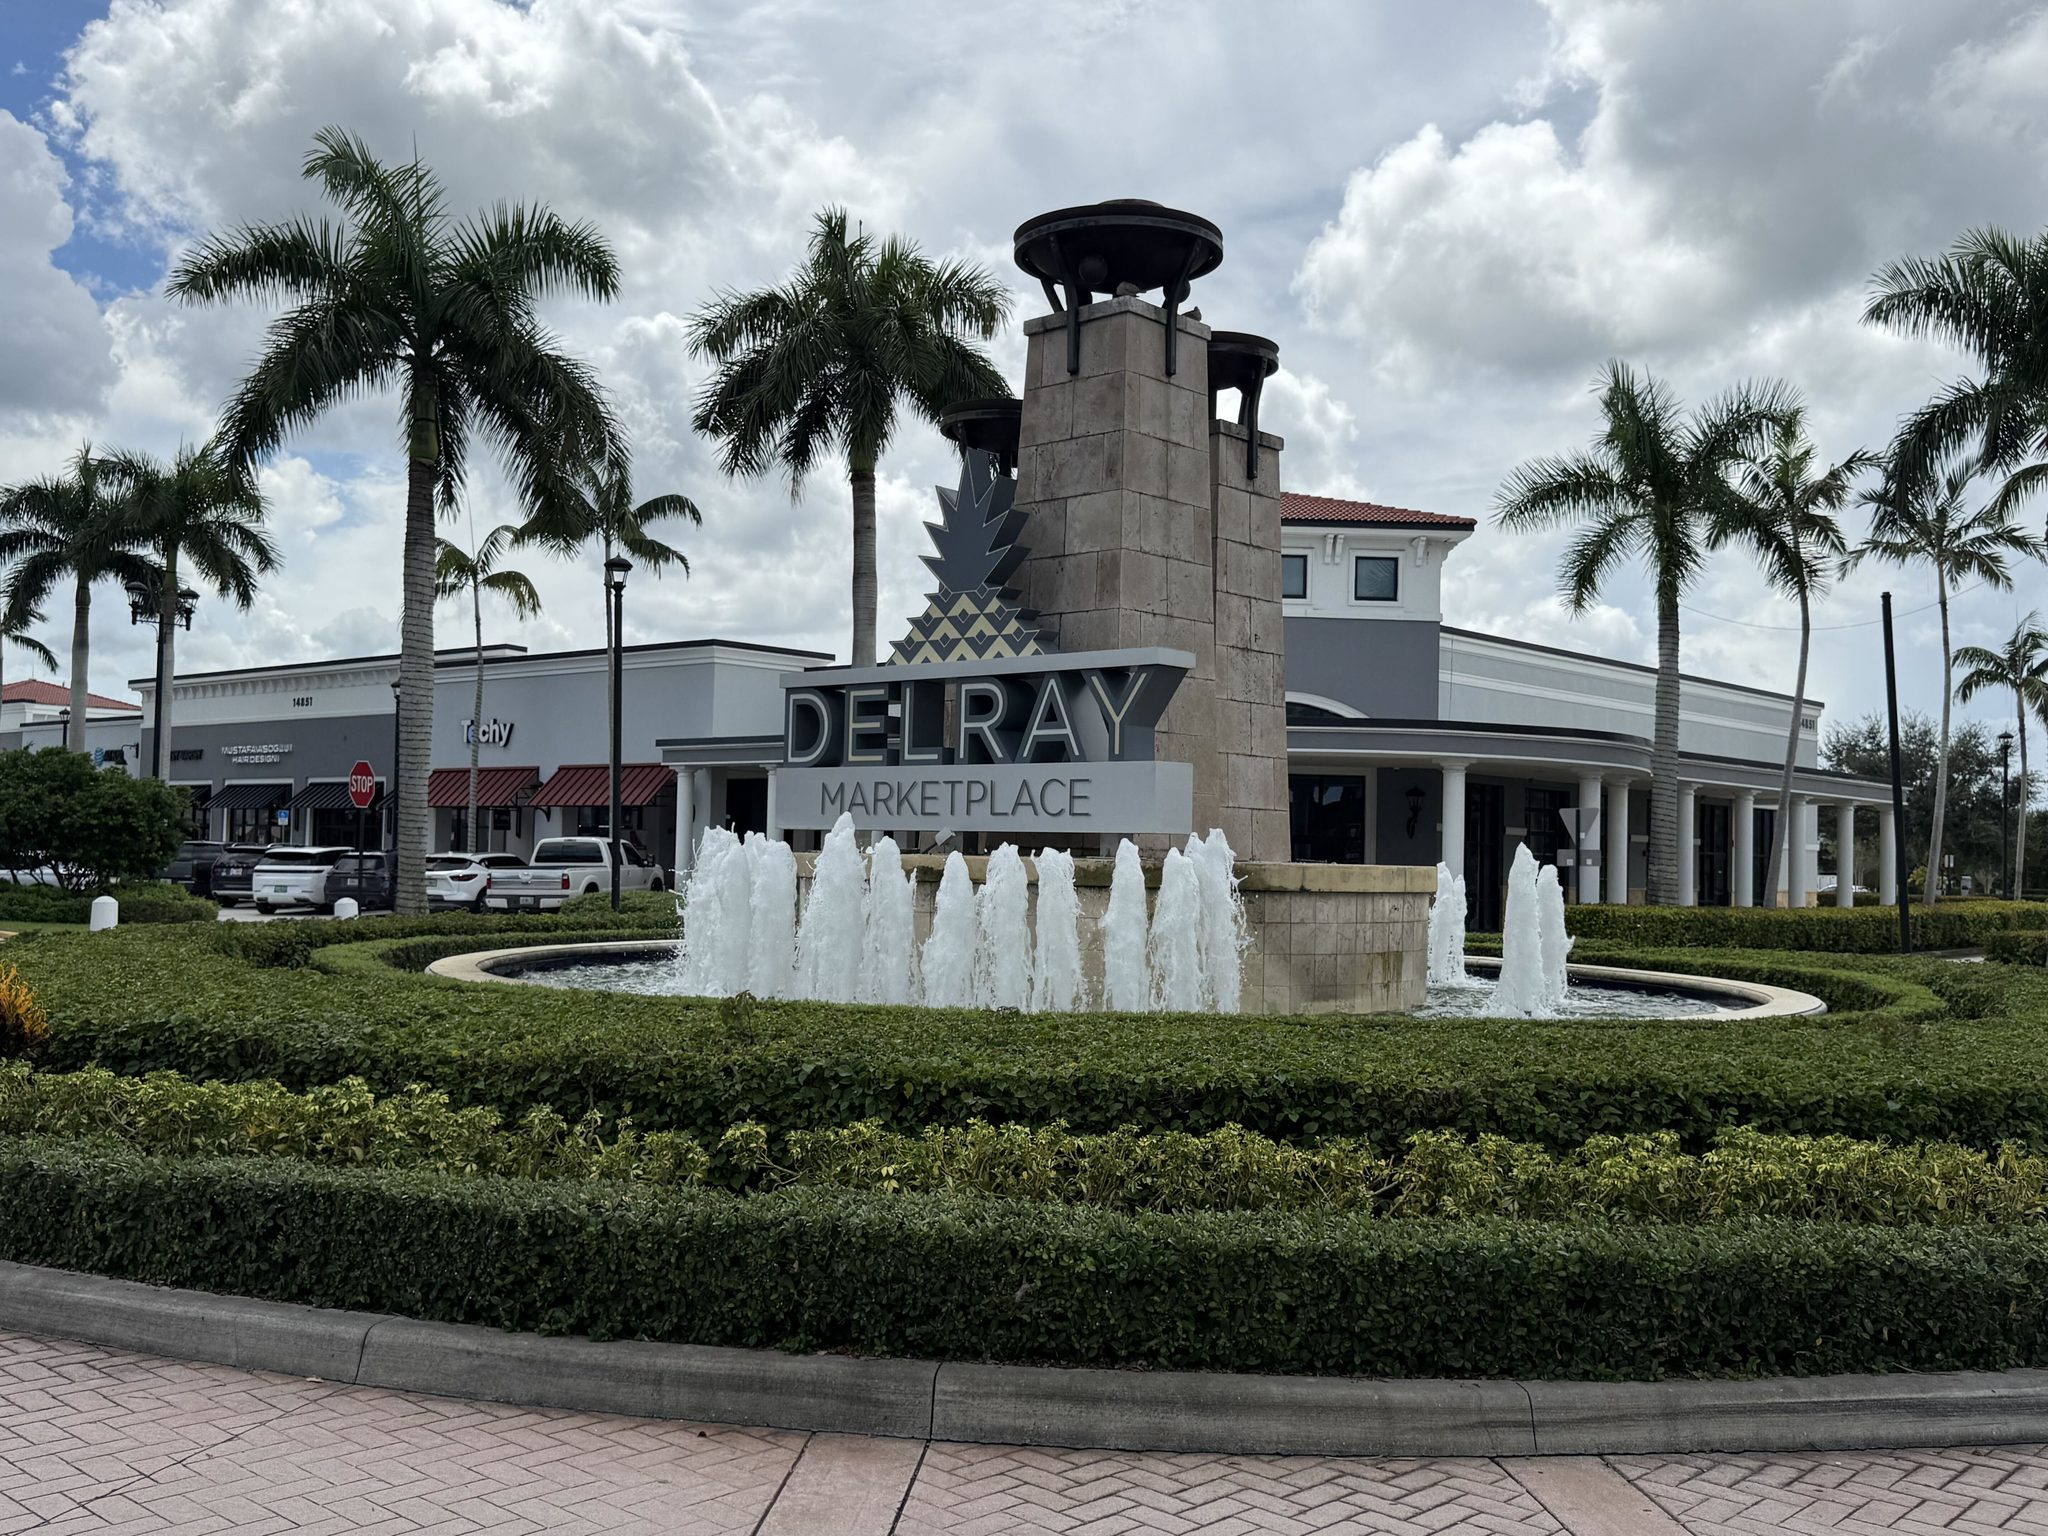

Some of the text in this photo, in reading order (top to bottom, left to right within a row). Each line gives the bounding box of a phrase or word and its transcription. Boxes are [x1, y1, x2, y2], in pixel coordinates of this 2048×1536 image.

[293, 696, 313, 709] 14851
[783, 667, 1180, 768] DELRAY
[1799, 718, 1815, 731] 4851
[351, 775, 373, 793] STOP
[820, 778, 1092, 817] MARKETPLACE
